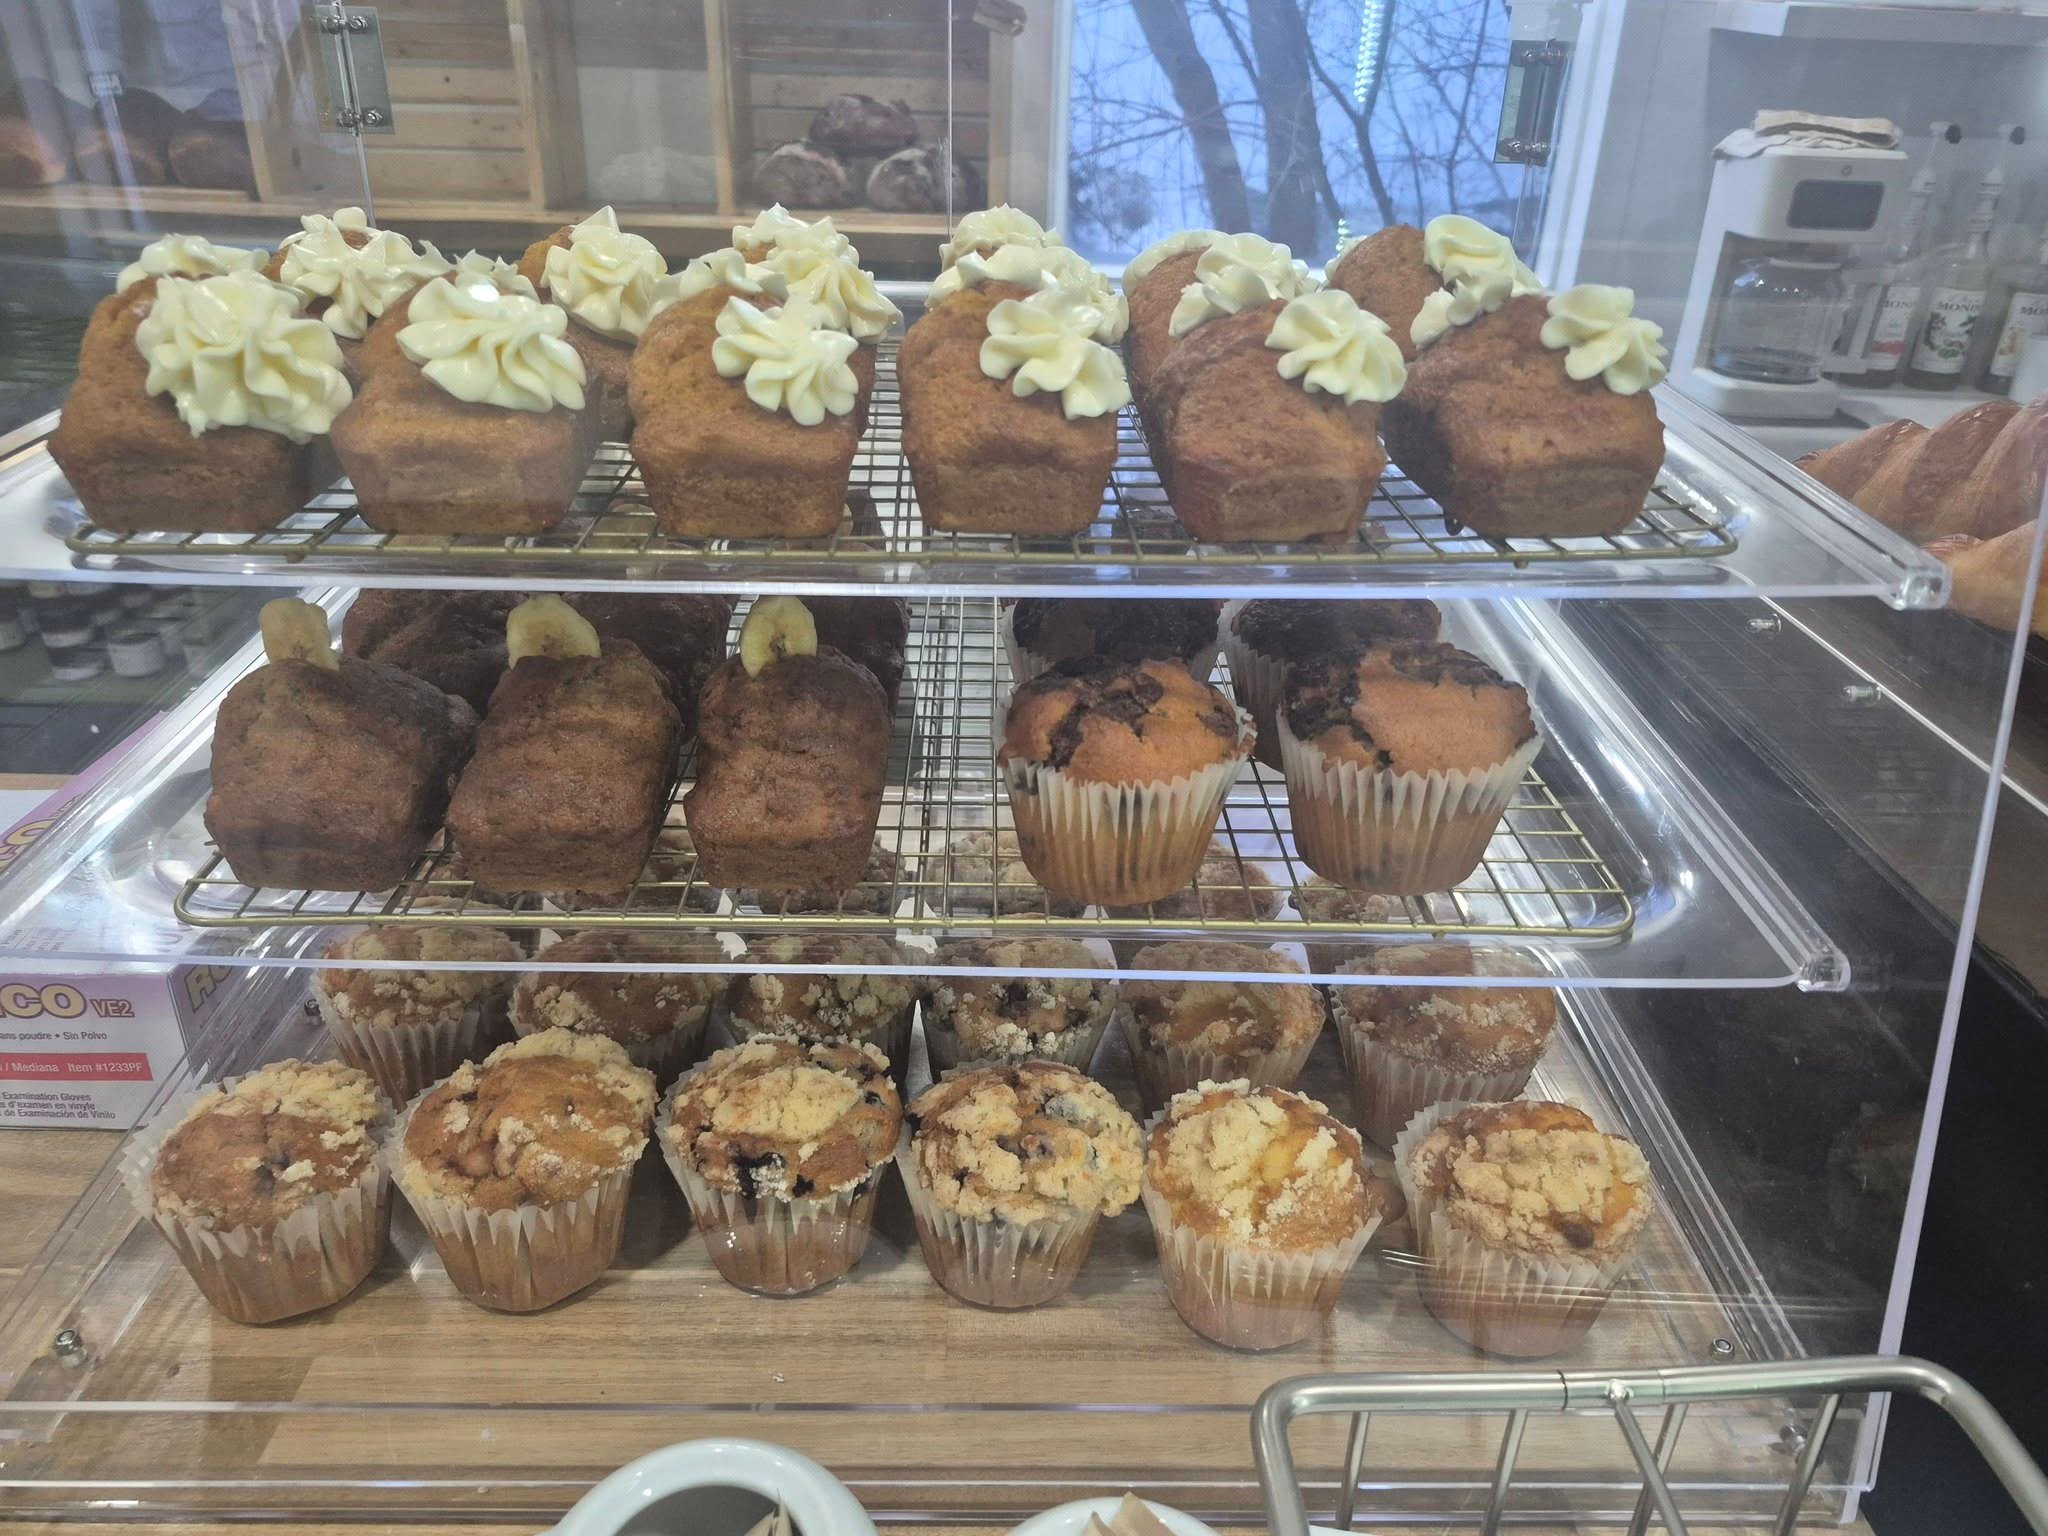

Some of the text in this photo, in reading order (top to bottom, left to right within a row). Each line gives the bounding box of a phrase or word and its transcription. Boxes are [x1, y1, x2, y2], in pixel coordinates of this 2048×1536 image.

[0, 983, 136, 1019] CO VE2
[19, 1031, 52, 1041] poudre
[63, 1031, 79, 1040] Sin
[81, 1031, 107, 1040] Polvo
[12, 1062, 59, 1072] Mediana
[67, 1062, 92, 1072] Item
[95, 1062, 143, 1073] #1233PF
[2, 1092, 92, 1102] Examination Gloves
[4, 1109, 16, 1117] de
[77, 1111, 89, 1119] de
[91, 1111, 116, 1119] Vinilo
